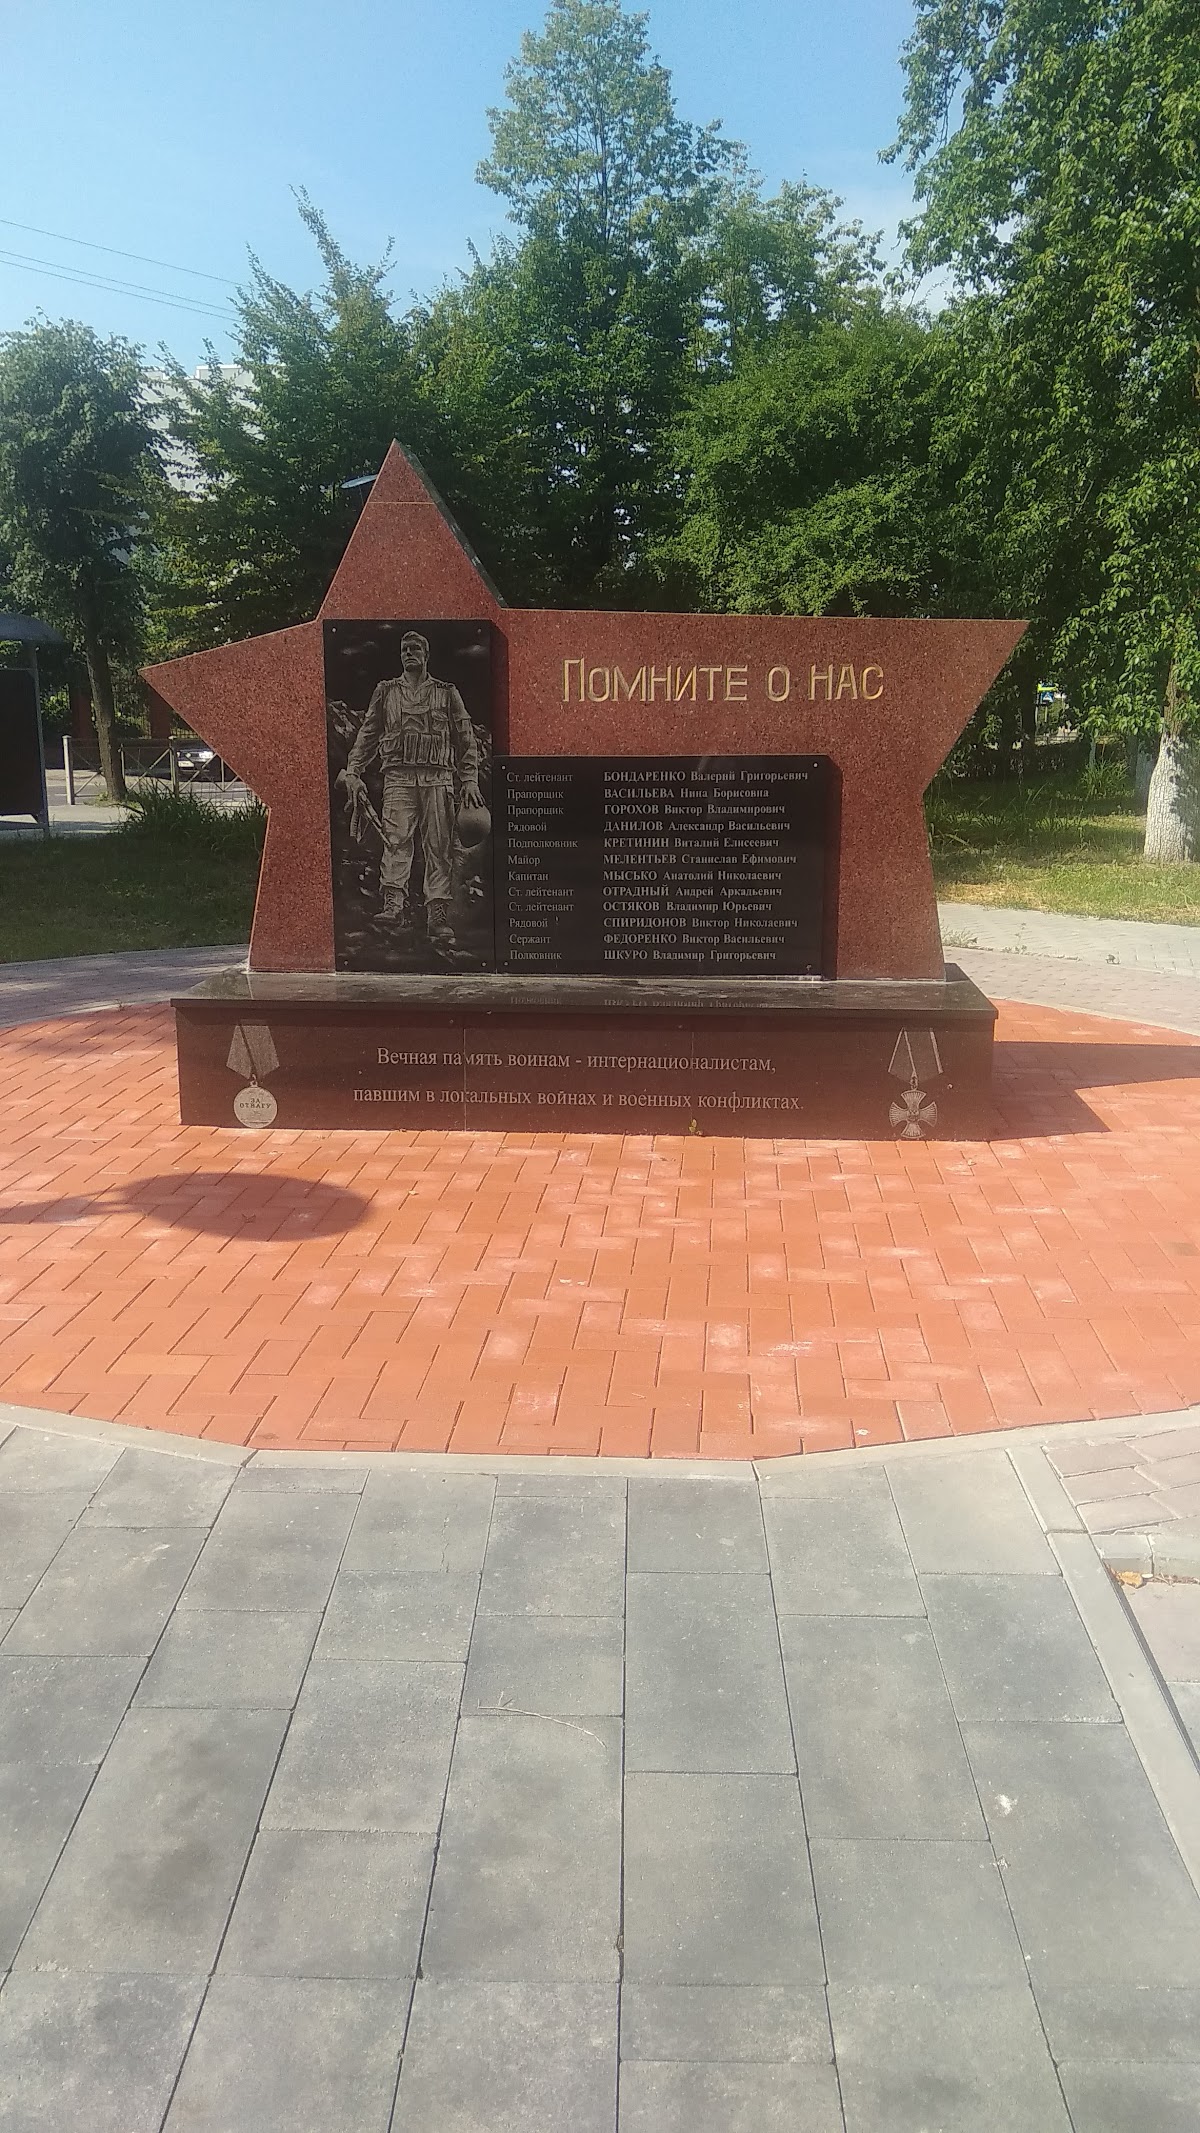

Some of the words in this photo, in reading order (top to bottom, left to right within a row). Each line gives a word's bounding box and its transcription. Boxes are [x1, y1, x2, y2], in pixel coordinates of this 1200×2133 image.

[563, 658, 748, 702] ПОМНИТЕ
[767, 664, 790, 702] О
[808, 663, 884, 701] НАС
[506, 772, 521, 782] Ст.
[524, 772, 573, 782] лейтенант
[604, 771, 686, 783] БОНДАРЕНКО
[691, 771, 735, 783] Валерий
[740, 770, 808, 783] Григорьевич
[507, 789, 564, 801] Прапорщик
[604, 788, 675, 799] ВАСИЛЬЕВА
[680, 788, 708, 798] Нина
[713, 788, 769, 800] Борисовна
[507, 805, 564, 817] Прапорщик
[604, 804, 659, 815] ГОРОХОВ
[664, 804, 703, 816] Виктор
[707, 804, 785, 816] Владимирович
[508, 821, 547, 832] Рядовой
[604, 821, 663, 832] ДАНИЛОВ
[668, 821, 725, 833] Александр
[728, 821, 791, 832] Васильевич
[508, 838, 578, 849] Подполковник
[604, 838, 669, 848] КРЕТИНИН
[674, 837, 719, 848] Виталий
[724, 837, 779, 848] Елисеевич
[508, 854, 541, 867] Майор
[603, 854, 677, 864] МЕЛЕНТЬЕВ
[681, 854, 738, 864] Станислав
[742, 854, 797, 865] Ефимович
[508, 871, 549, 881] Капитан
[603, 871, 658, 881] МЫСЬКО
[663, 871, 713, 881] Анатолий
[718, 871, 782, 880] Николаевич
[508, 887, 522, 897] Ст.
[525, 887, 574, 897] лейтенант
[602, 884, 669, 897] ОТРАДНЫЙ
[675, 886, 714, 898] Андрей
[719, 886, 782, 898] Аркадьевич
[508, 902, 522, 912] Ст.
[525, 902, 574, 912] лейтенант
[602, 901, 659, 911] ОСТЯКОВ
[666, 901, 719, 913] Владимир
[722, 901, 772, 913] Юрьевич
[508, 918, 548, 928] Рядовой
[603, 917, 687, 928] СПИРИДОНОВ
[692, 918, 730, 929] Виктор
[734, 917, 798, 928] Николаевич
[509, 933, 551, 946] Сержант
[603, 933, 677, 945] ФЕДОРЕНКО
[682, 933, 720, 946] Виктор
[723, 933, 785, 944] Васильевич
[510, 950, 562, 960] Полковник
[604, 950, 648, 960] ШКУРО
[653, 950, 705, 962] Владимир
[710, 949, 776, 962] Григорьевич
[377, 1047, 437, 1064] Вечная
[442, 1051, 502, 1067] память
[507, 1053, 570, 1067] воинам
[587, 1054, 776, 1074] интернационалистам,
[353, 1088, 420, 1102] павшим
[426, 1091, 435, 1102] в
[440, 1089, 532, 1104] локальных
[537, 1090, 597, 1106] войнах
[602, 1094, 614, 1105] и
[618, 1093, 691, 1107] военных
[698, 1091, 804, 1113] конфликтах.
